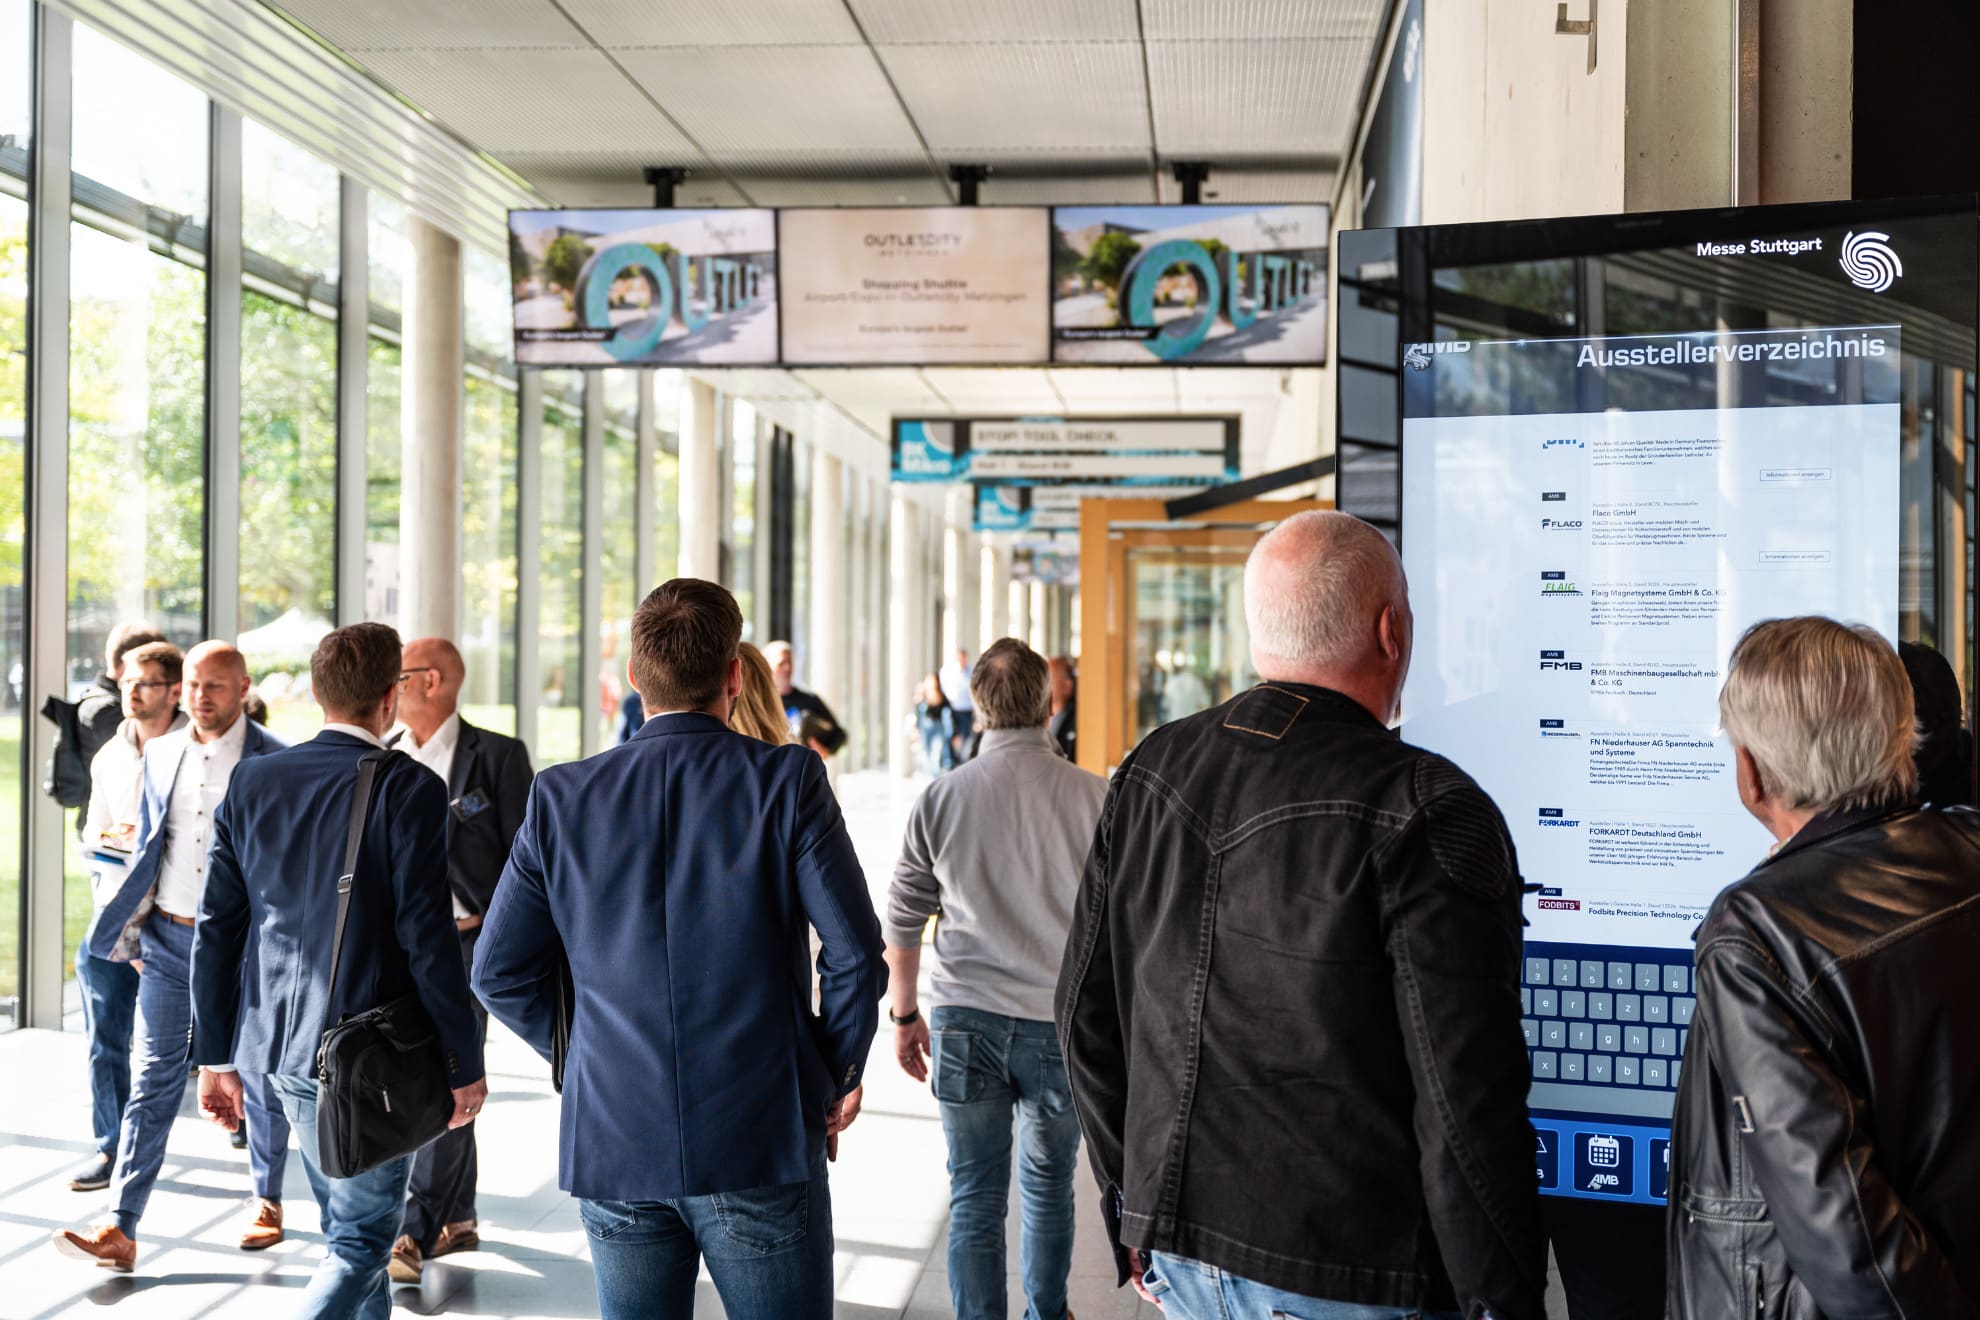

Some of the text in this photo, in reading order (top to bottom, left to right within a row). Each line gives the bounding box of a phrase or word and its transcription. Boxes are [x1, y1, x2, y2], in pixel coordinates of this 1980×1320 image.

[1697, 237, 1823, 256] Messe Stuttgart
[861, 278, 968, 291] Shopping Shuttle
[1576, 333, 1886, 368] Ausstellerverzeichnis
[1545, 582, 1576, 592] FLAIG
[1592, 590, 1609, 598] Flaig
[1540, 662, 1582, 670] FMB
[1608, 670, 1702, 678] Maschinenbaugesellschaft
[1602, 738, 1650, 746] Niederhauser
[1665, 740, 1714, 748] Spanntechnik
[1606, 749, 1636, 757] Systeme
[1538, 819, 1580, 827] FORKARDT
[1632, 830, 1676, 838] Deutschland
[1539, 900, 1576, 910] FODBITS
[1588, 908, 1614, 916] Fodbits
[1616, 909, 1648, 917] Precision
[1650, 910, 1692, 920] Technology
[1616, 977, 1623, 985] 6
[1598, 1002, 1603, 1010] t
[1682, 1006, 1686, 1016] i
[1551, 1030, 1557, 1039] d
[1579, 1031, 1584, 1040] f
[1605, 1035, 1612, 1045] g
[1633, 1035, 1640, 1045] h
[1660, 1037, 1665, 1048] j
[1596, 1066, 1603, 1074] v
[1624, 1066, 1631, 1076] b
[1651, 1069, 1658, 1077] n
[1590, 1173, 1620, 1186] AMB
